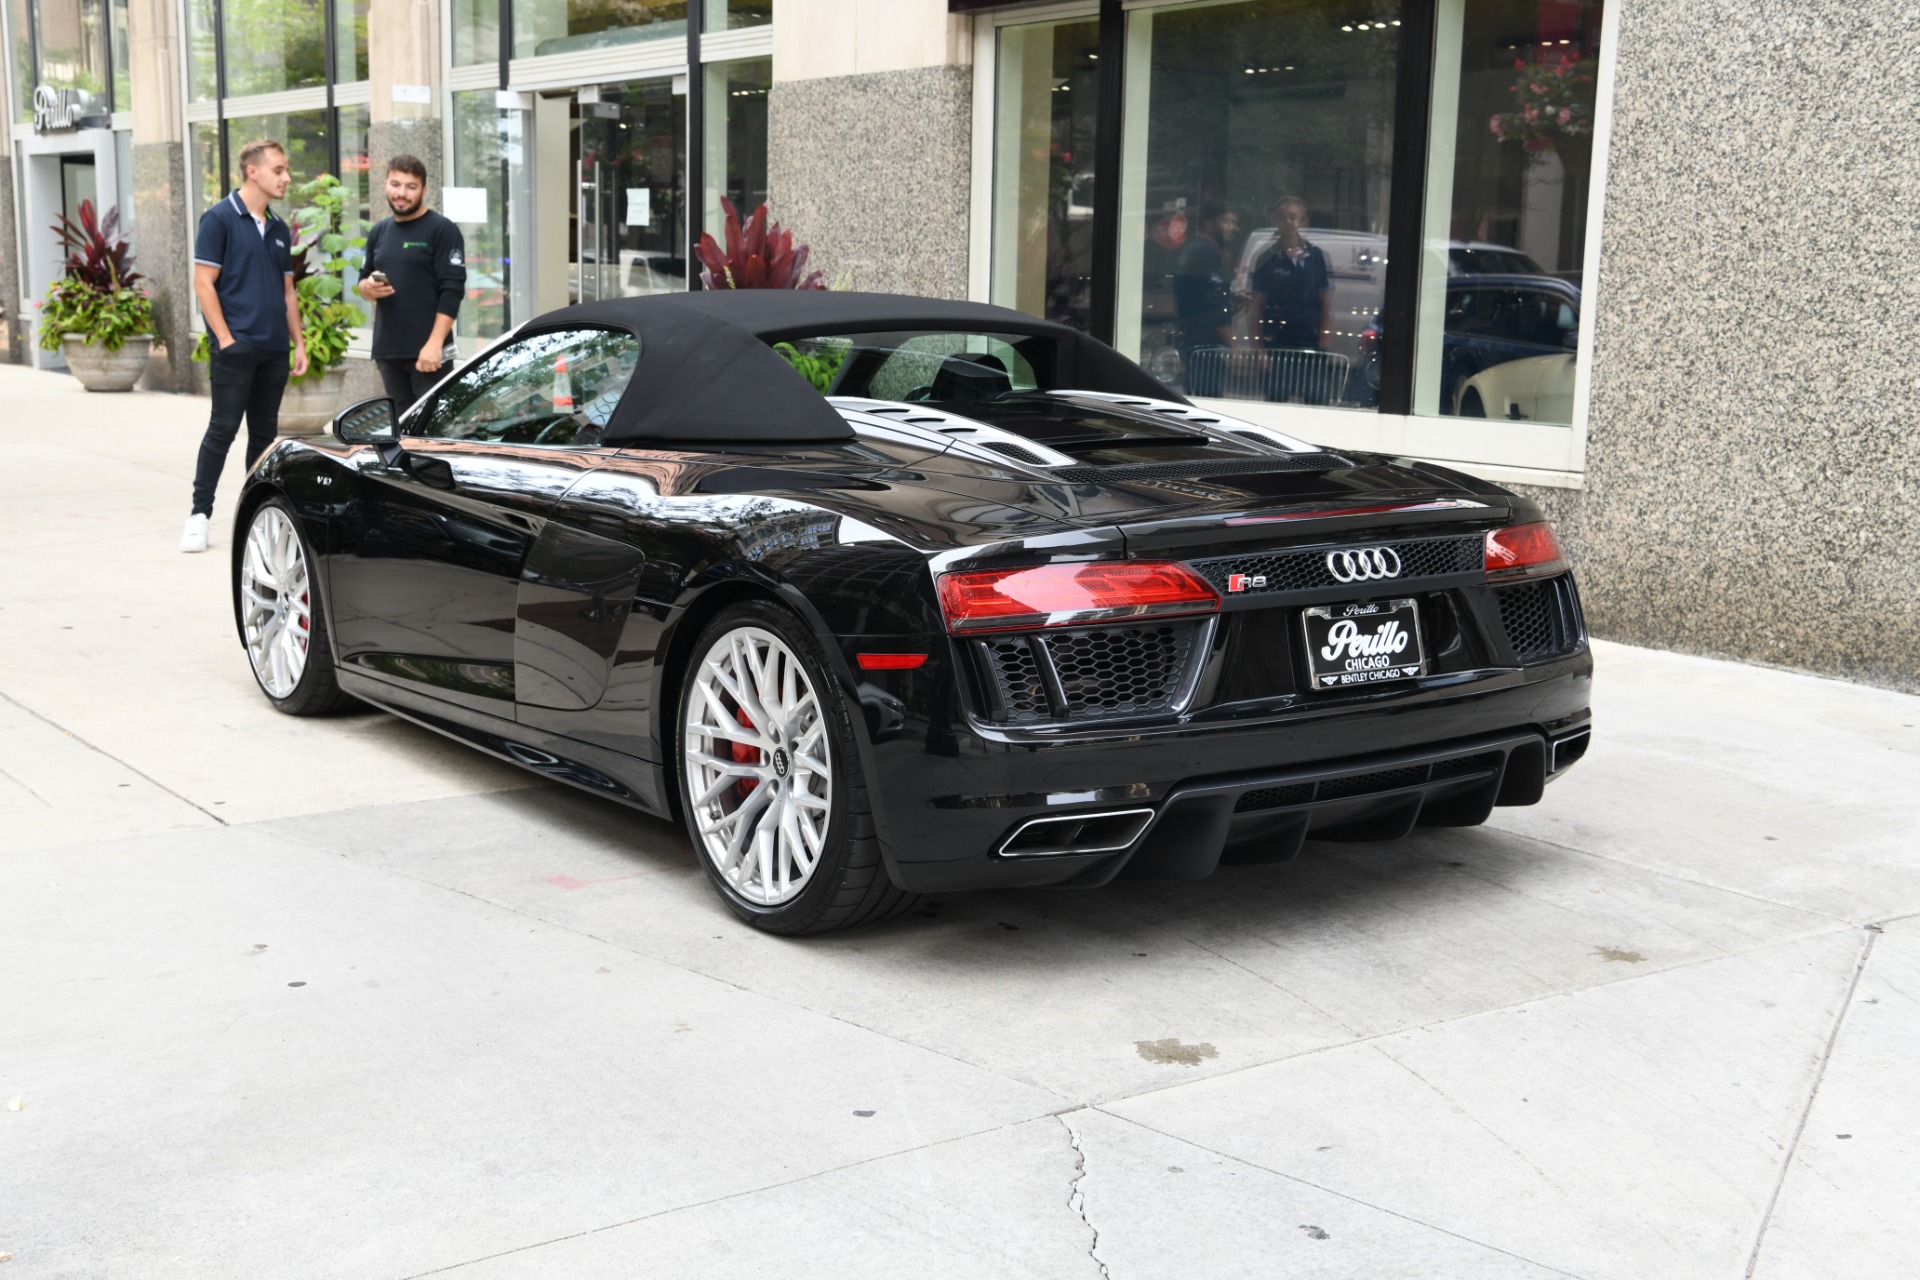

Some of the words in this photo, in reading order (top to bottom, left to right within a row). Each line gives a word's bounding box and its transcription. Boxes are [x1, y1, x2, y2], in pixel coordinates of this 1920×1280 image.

[33, 85, 79, 131] Perillo
[317, 475, 332, 485] V10
[1237, 575, 1267, 589] R8
[1342, 603, 1380, 616] Perillo
[1321, 620, 1408, 661] Perillo
[1345, 655, 1390, 671] CHICAGO
[1341, 672, 1368, 684] BENTLEY
[1368, 668, 1400, 681] CHICAGO
